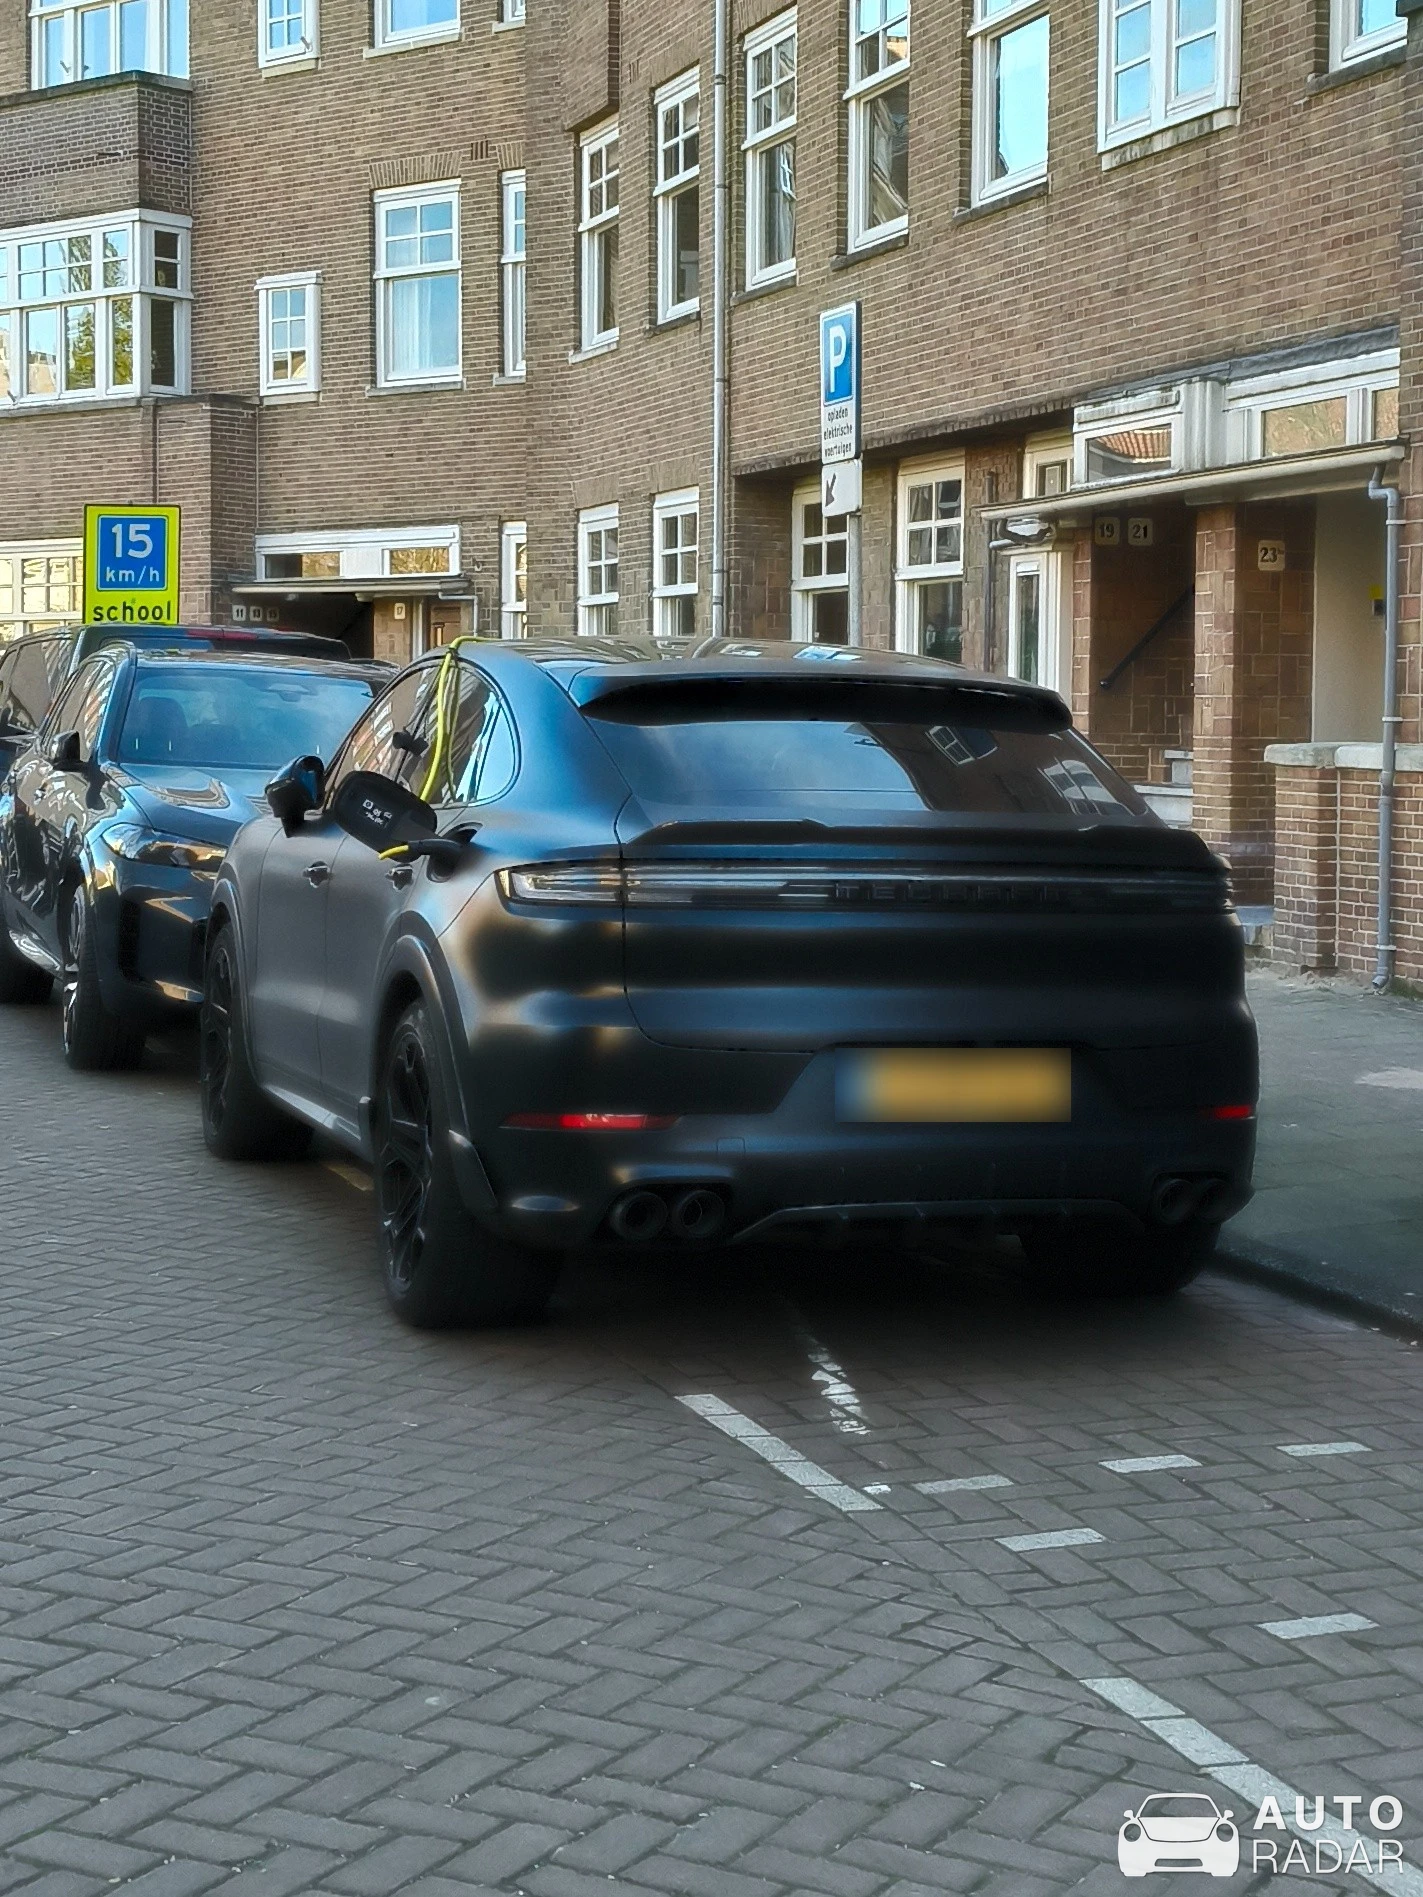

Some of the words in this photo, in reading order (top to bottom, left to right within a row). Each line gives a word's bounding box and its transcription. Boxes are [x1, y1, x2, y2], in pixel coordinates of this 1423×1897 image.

[830, 325, 847, 393] P
[828, 406, 848, 422] opladen
[824, 423, 852, 440] elektrische
[825, 442, 851, 457] voertuigen
[1100, 523, 1115, 538] 19
[1132, 524, 1148, 538] 21
[111, 523, 153, 559] 15
[106, 566, 160, 585] km/h
[93, 601, 171, 621] school
[236, 608, 244, 618] 11
